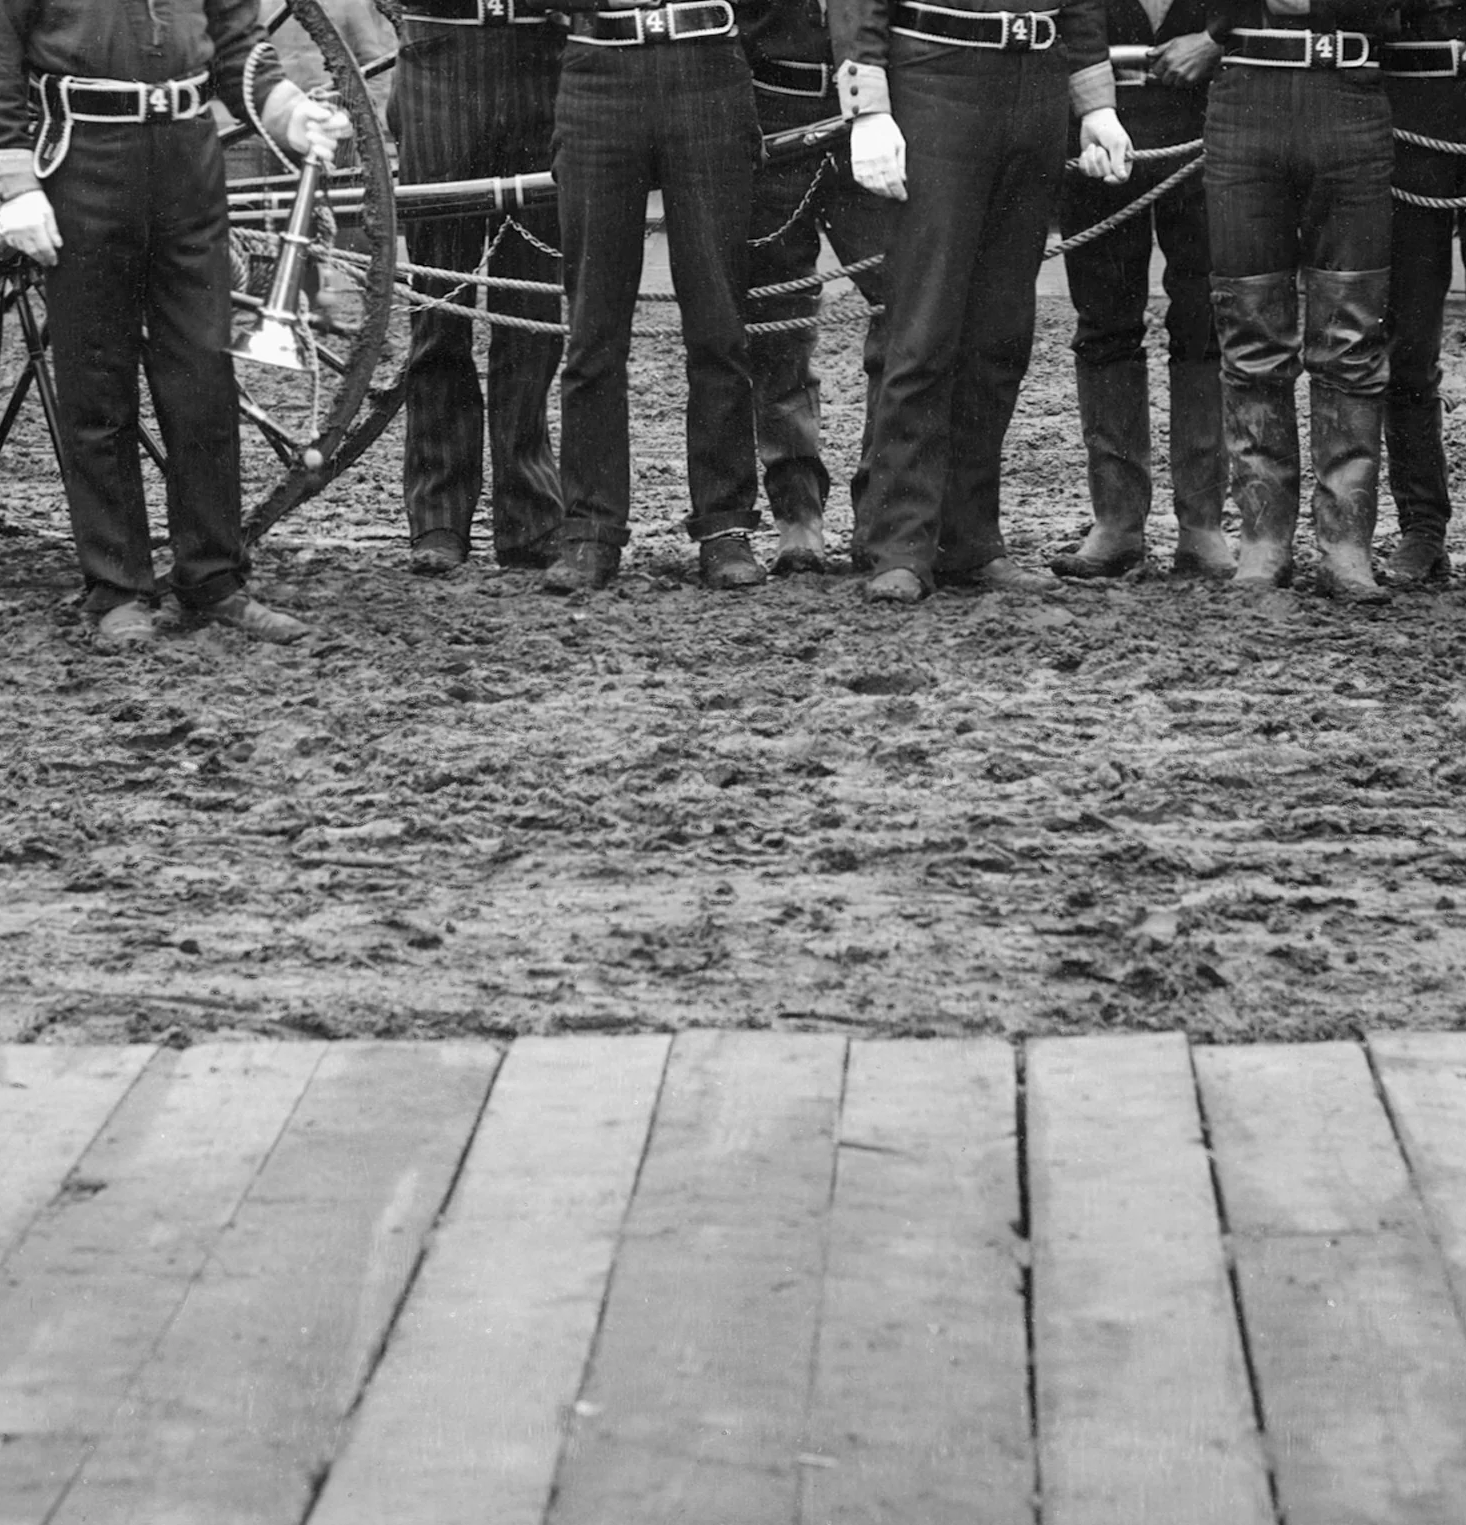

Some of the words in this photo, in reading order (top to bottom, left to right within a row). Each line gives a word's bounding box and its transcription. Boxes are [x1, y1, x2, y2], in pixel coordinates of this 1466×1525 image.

[645, 12, 665, 33] 4
[1011, 18, 1029, 41] 4
[1315, 36, 1334, 58] 4
[149, 88, 170, 113] 4
